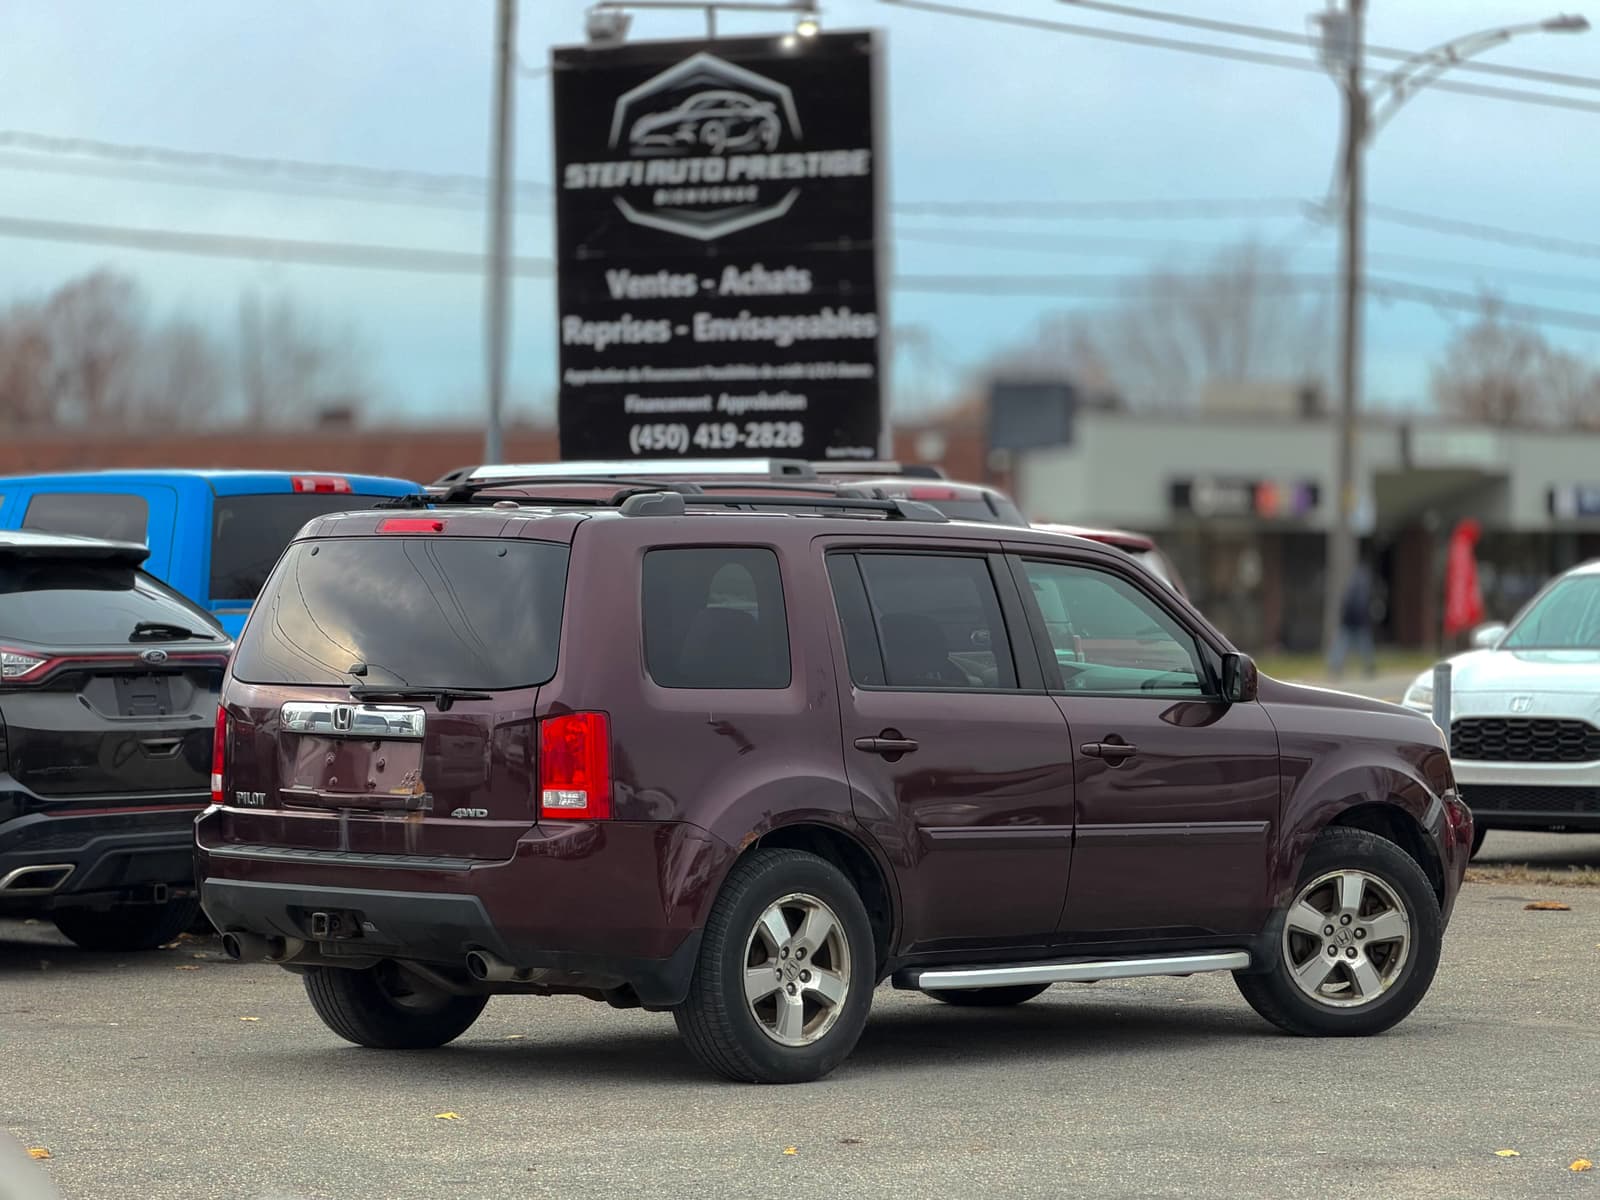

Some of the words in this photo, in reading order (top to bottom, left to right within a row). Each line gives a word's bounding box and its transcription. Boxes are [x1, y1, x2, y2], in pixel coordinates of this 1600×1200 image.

[645, 157, 725, 185] AUTO
[727, 149, 871, 181] PRESTIGE
[606, 268, 698, 299] Ventes
[719, 262, 812, 295] Achats
[562, 313, 672, 351] Reprises
[692, 306, 878, 347] Envisageables
[629, 423, 689, 455] (450)
[693, 421, 804, 449] 419-2828
[235, 791, 267, 806] PILOT
[450, 807, 488, 818] 4WD
